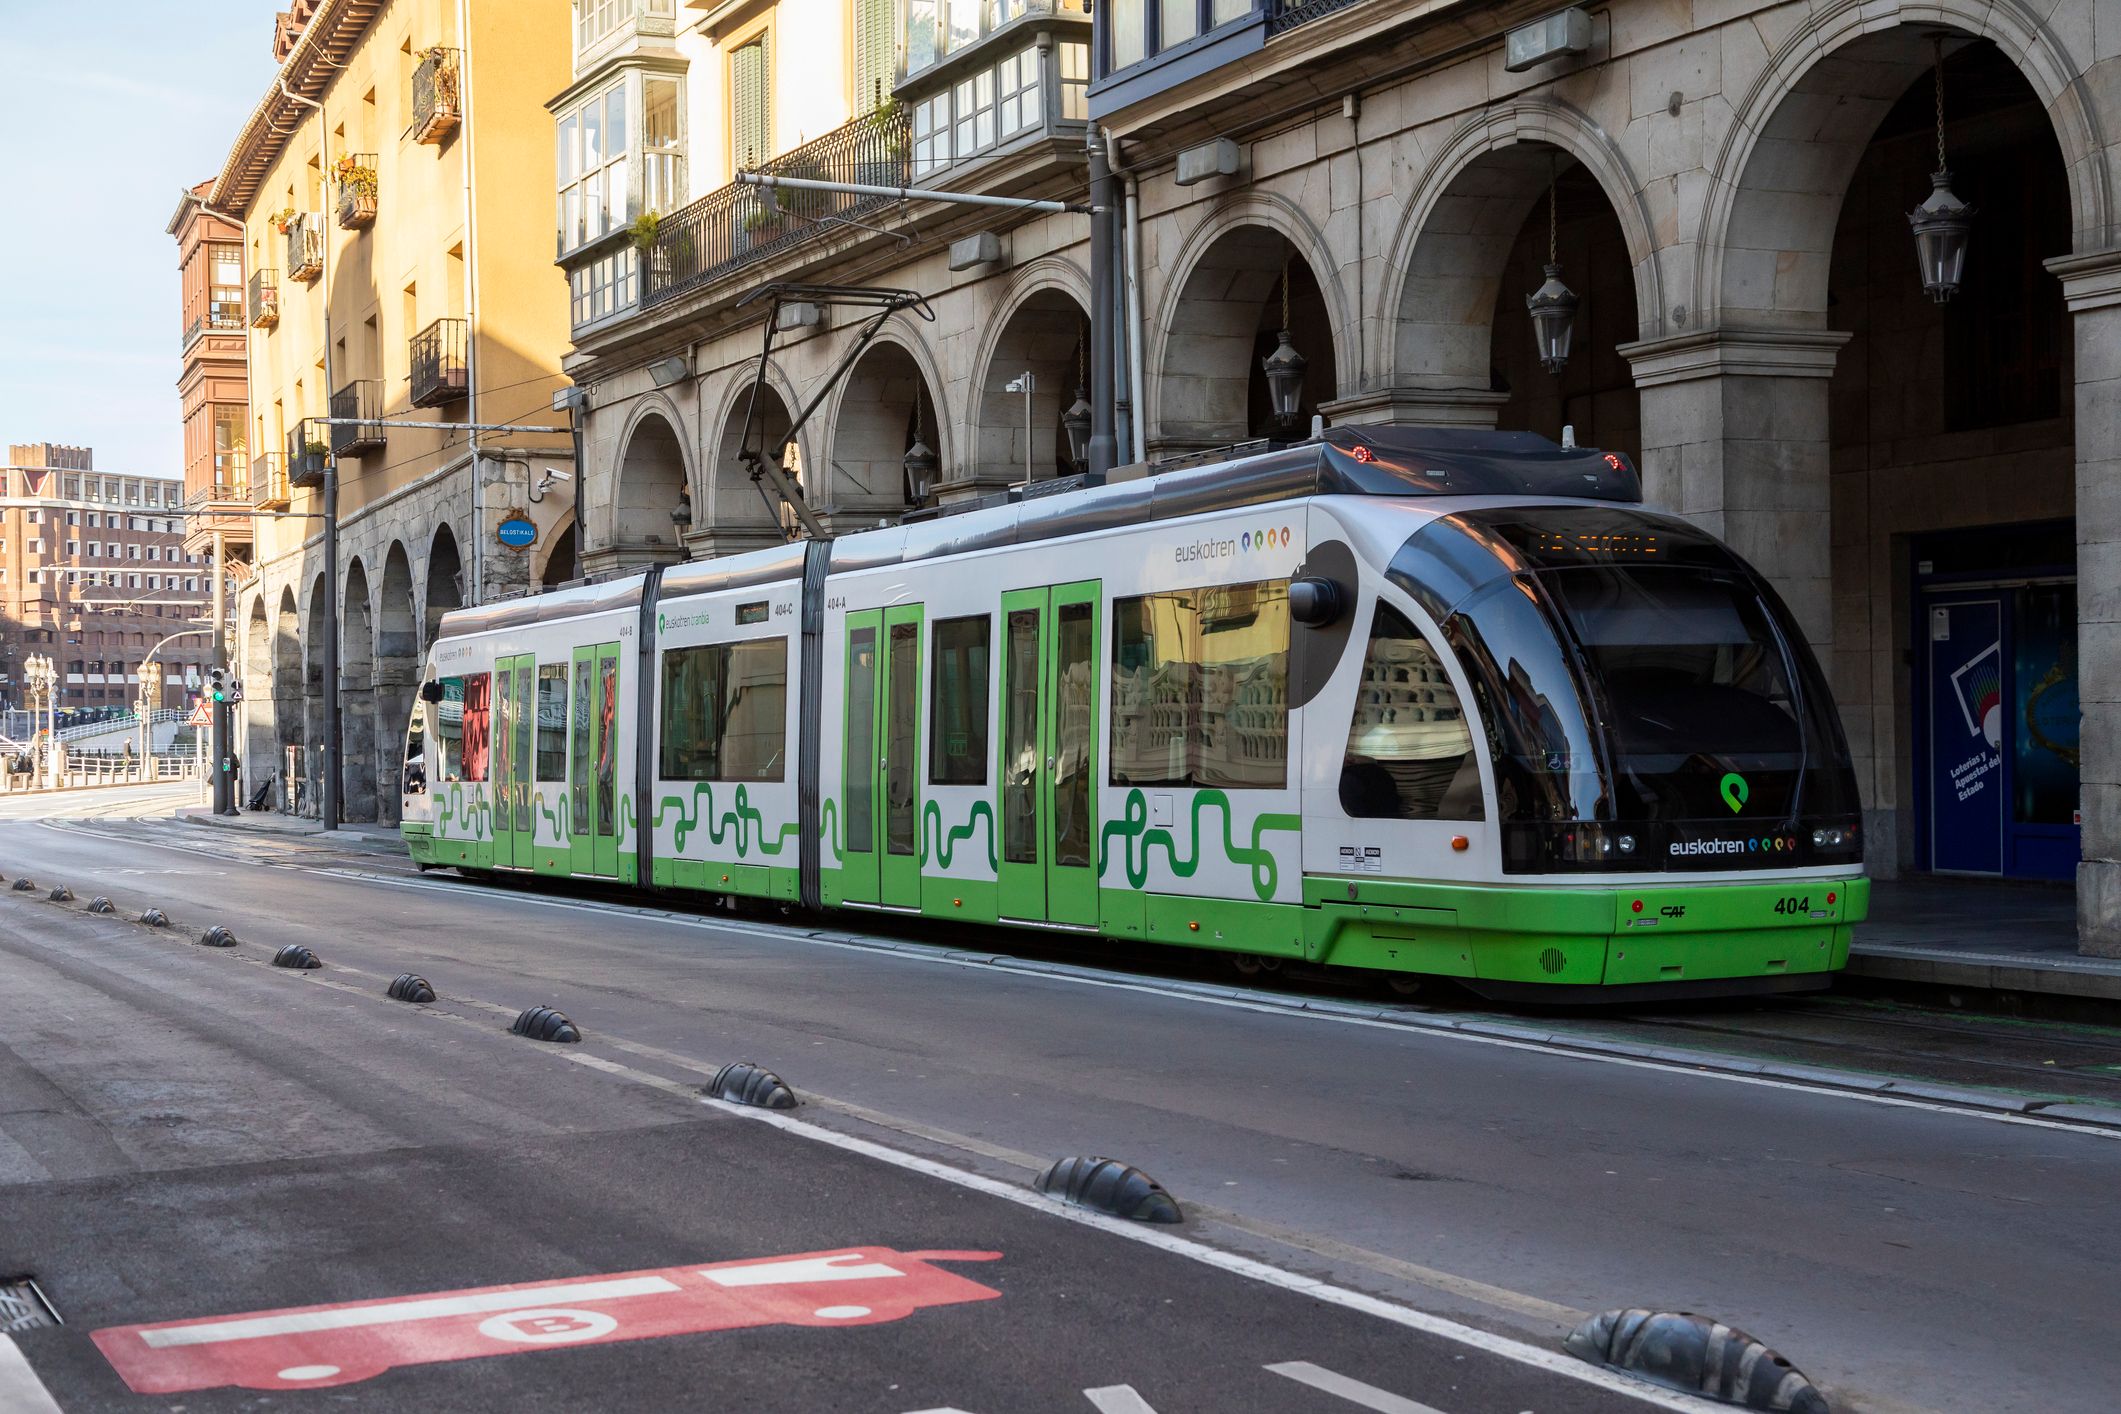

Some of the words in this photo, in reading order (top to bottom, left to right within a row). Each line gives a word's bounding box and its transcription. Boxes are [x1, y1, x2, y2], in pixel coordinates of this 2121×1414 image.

[1175, 537, 1236, 563] euskotren
[775, 602, 793, 617] 404-C
[827, 595, 846, 610] 404-A
[619, 625, 633, 637] 404-B
[666, 614, 690, 629] euskotren
[1950, 755, 1980, 778] Loterías
[1980, 751, 1987, 762] y
[1955, 763, 1989, 789] Apuestas
[1988, 754, 2000, 769] del
[1958, 780, 1985, 802] Estado
[1669, 837, 1745, 856] euskotren
[1660, 905, 1686, 918] CAF
[1774, 896, 1810, 915] 404
[507, 1315, 594, 1336] B
